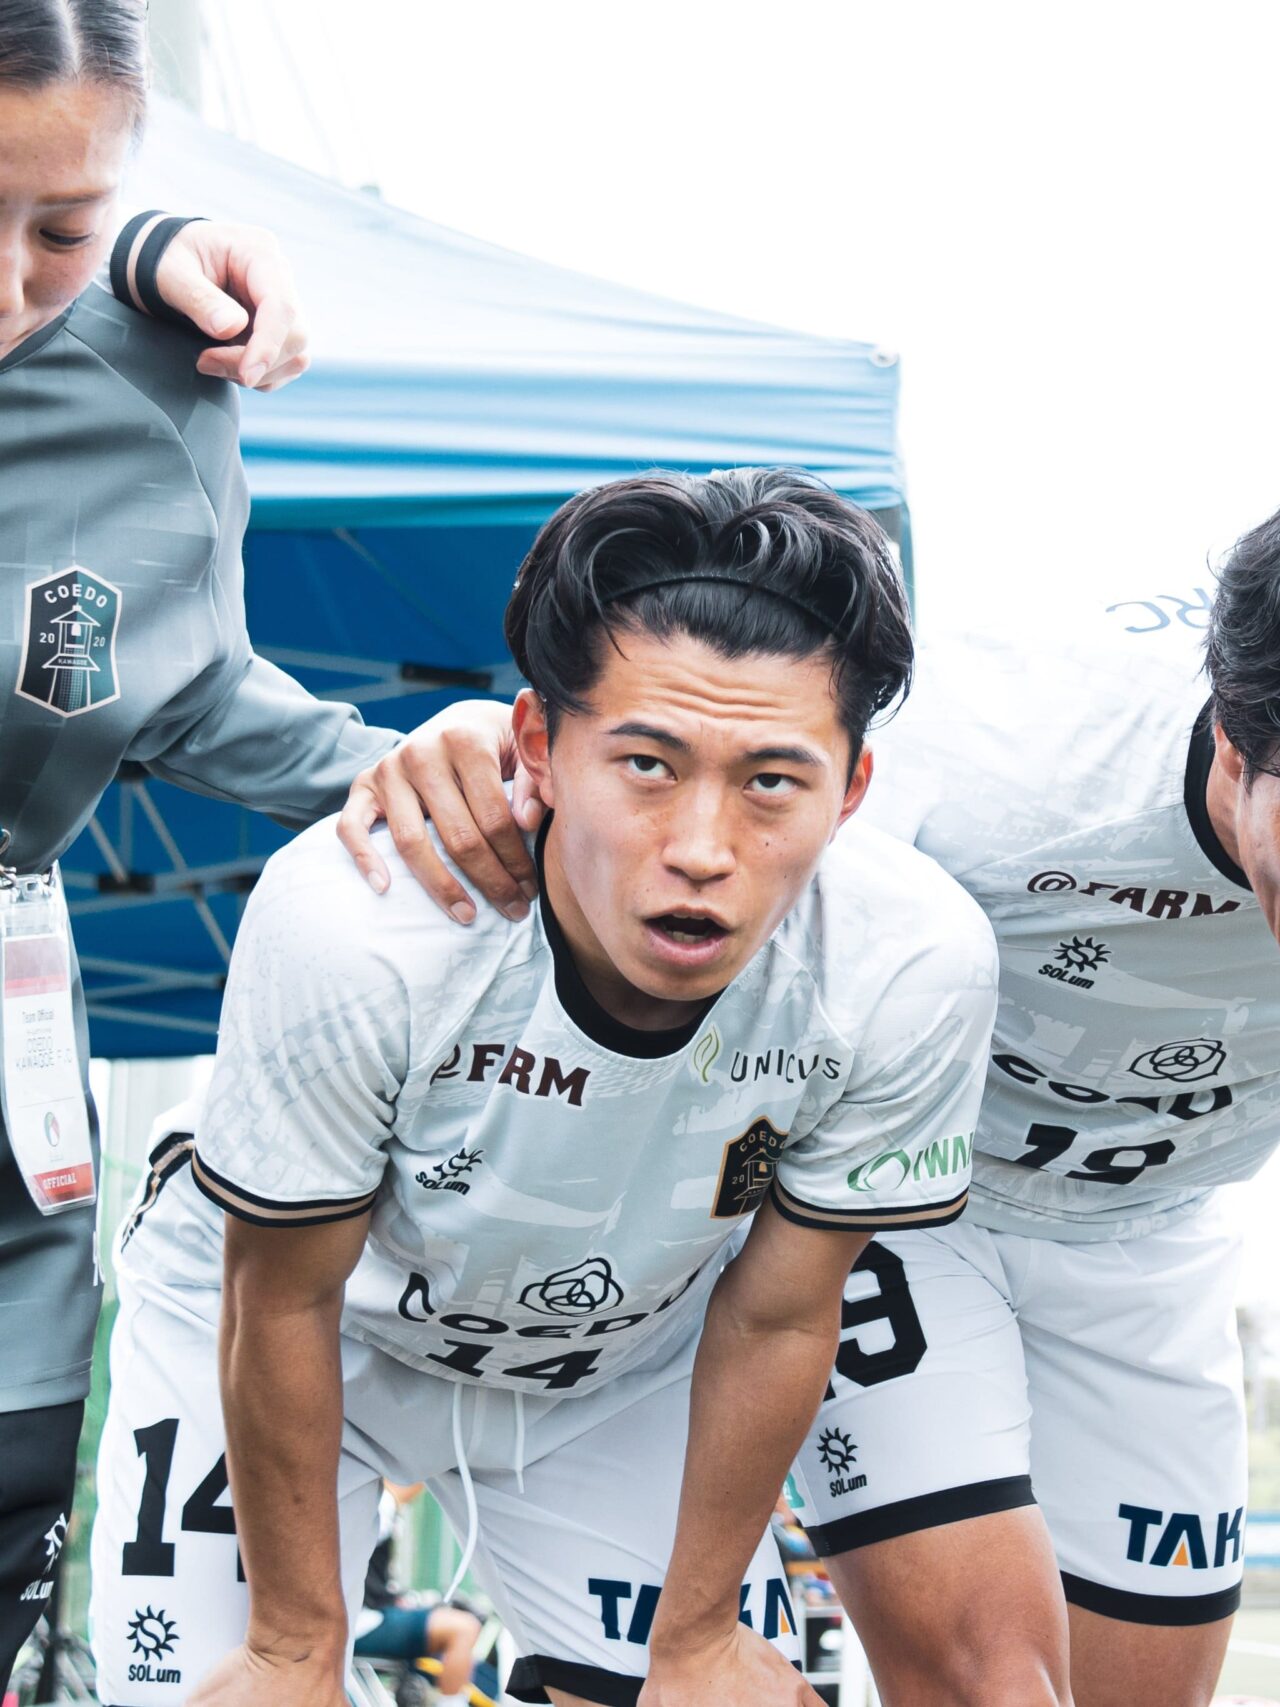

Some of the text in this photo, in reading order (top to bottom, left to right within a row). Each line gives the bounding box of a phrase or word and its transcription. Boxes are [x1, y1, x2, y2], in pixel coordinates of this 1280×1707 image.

[44, 583, 108, 608] COEDO
[39, 632, 55, 644] 20
[93, 636, 106, 647] 20
[1038, 963, 1095, 990] SOLum
[1012, 1123, 1176, 1185] 19
[732, 1174, 745, 1185] 20
[425, 1339, 604, 1390] 14
[830, 1474, 868, 1498] SOLum
[1118, 1503, 1246, 1570] TAK
[128, 1664, 182, 1684] SOLum
